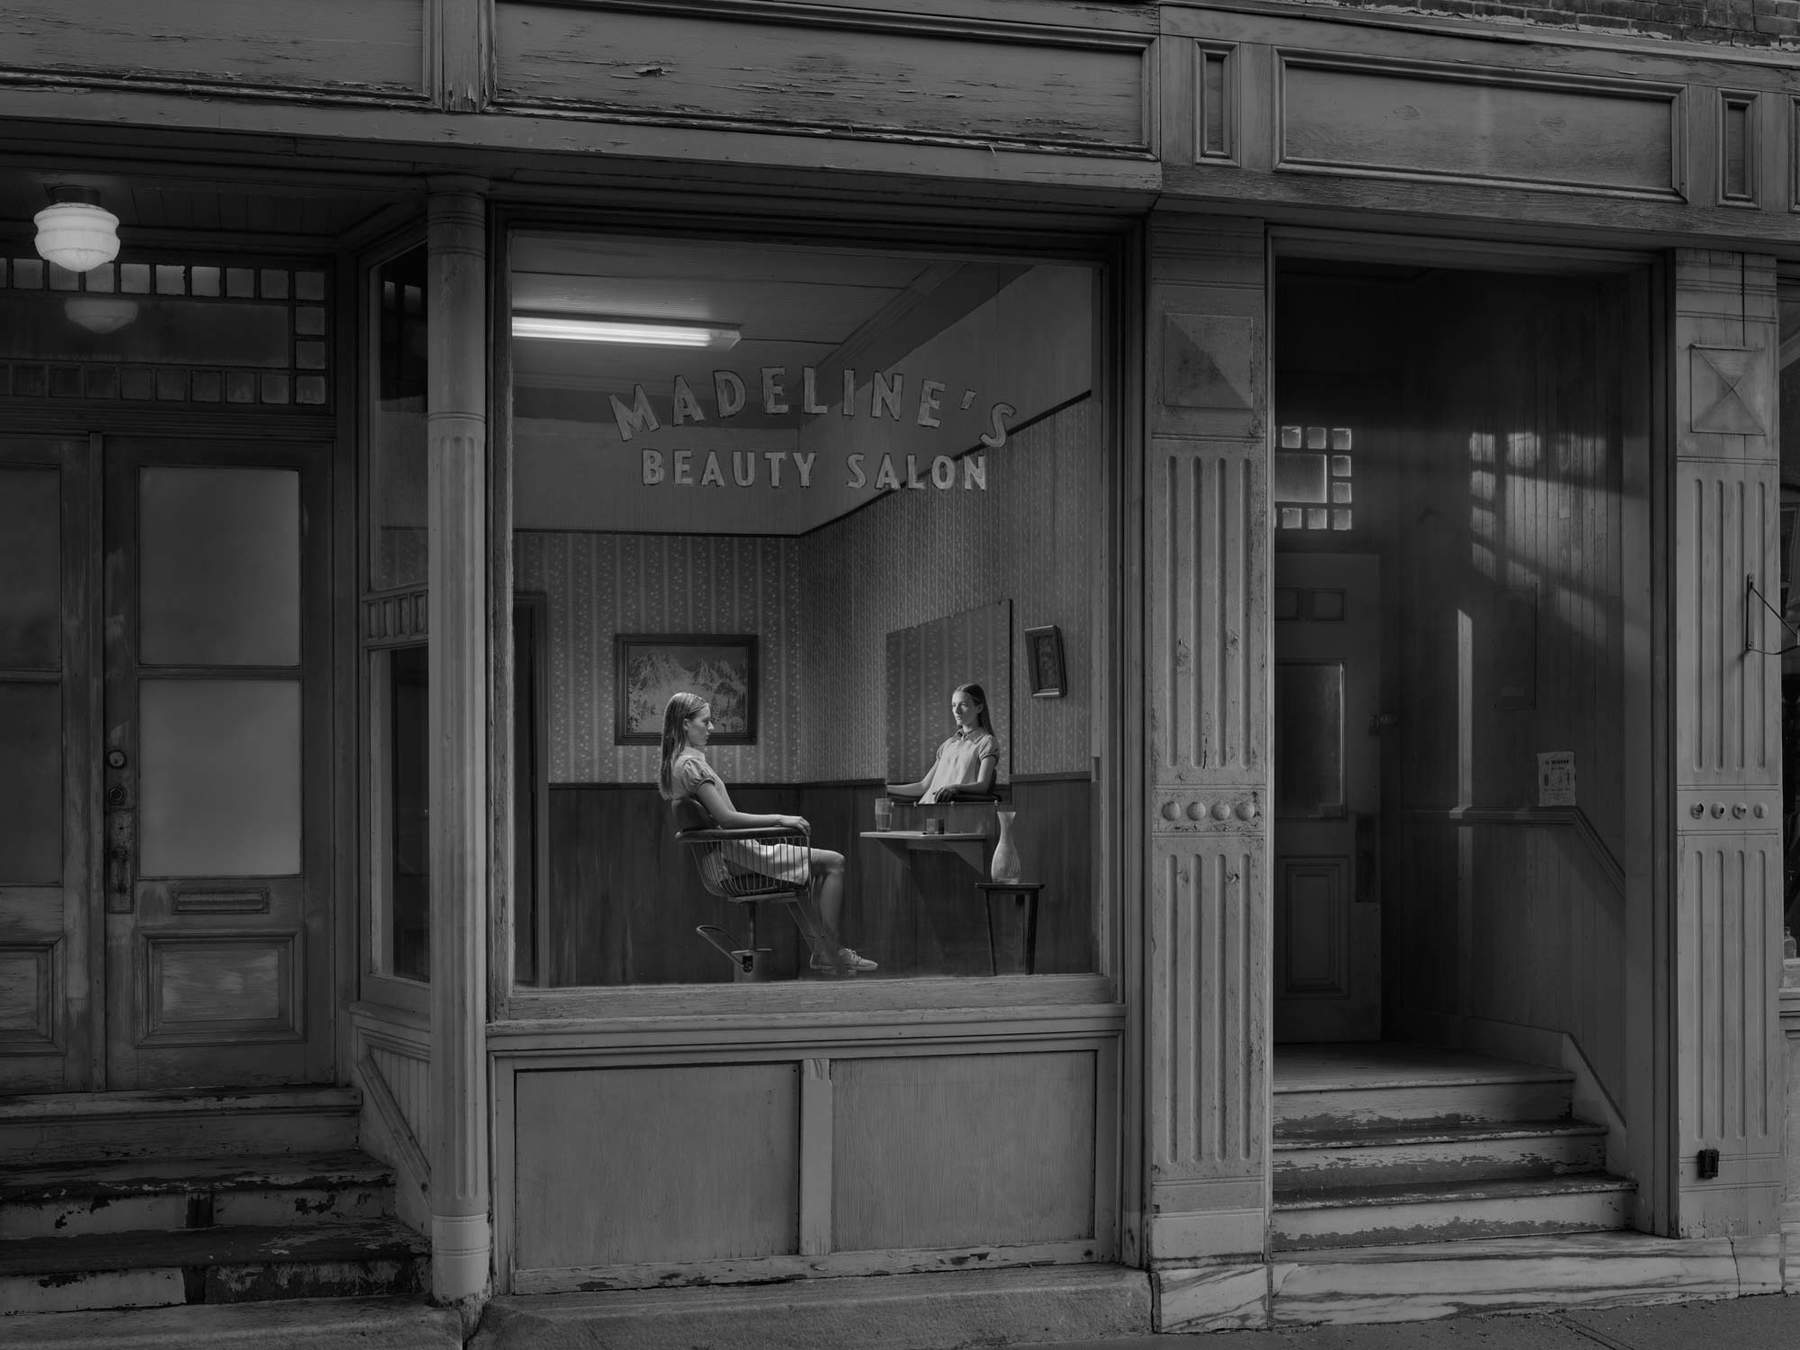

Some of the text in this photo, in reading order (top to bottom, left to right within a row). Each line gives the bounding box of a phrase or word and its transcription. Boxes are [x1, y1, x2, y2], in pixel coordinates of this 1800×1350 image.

[608, 366, 1017, 448] MADELINE'S
[641, 448, 988, 491] BEAUTY SALON
